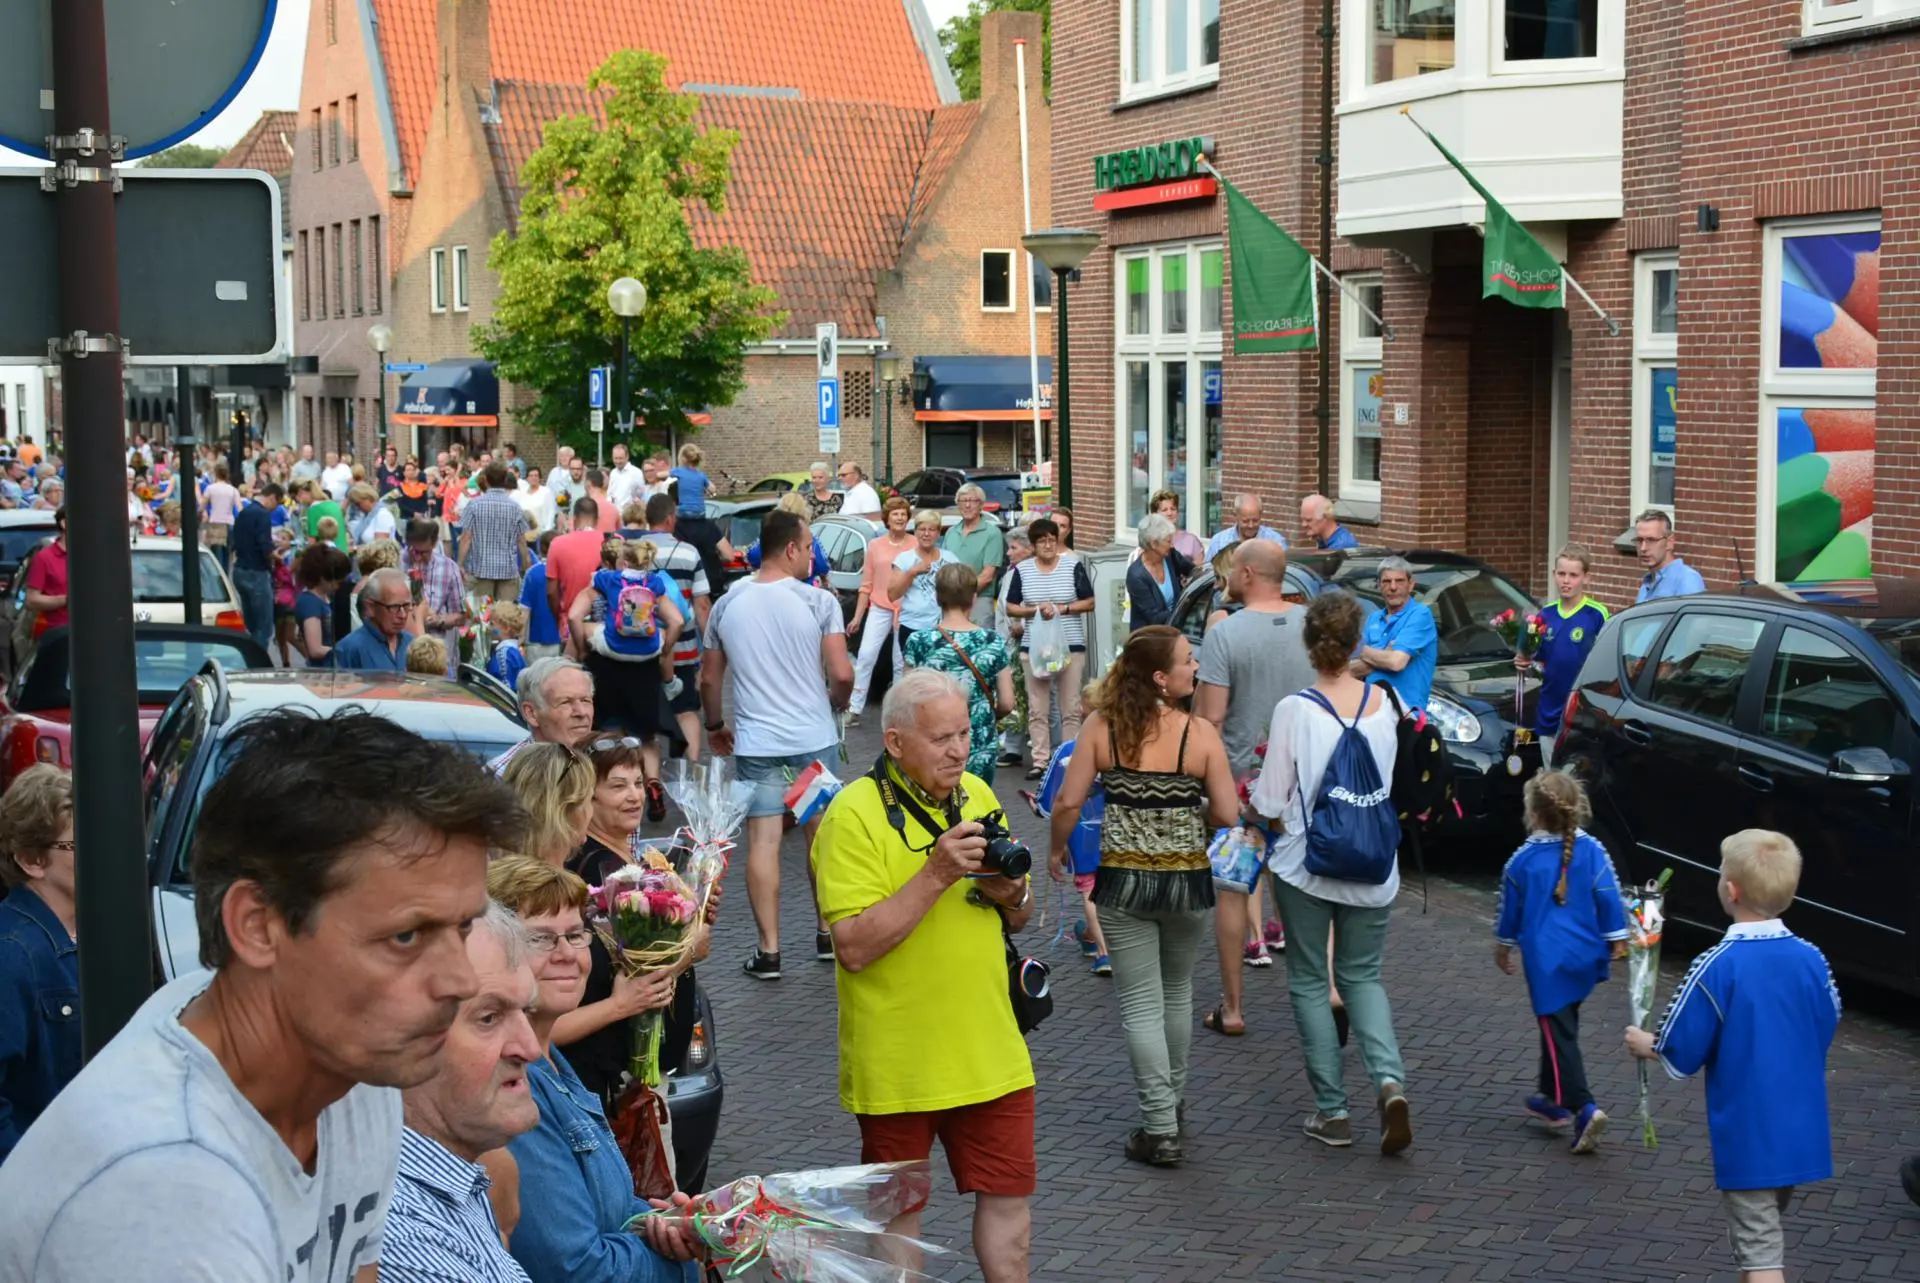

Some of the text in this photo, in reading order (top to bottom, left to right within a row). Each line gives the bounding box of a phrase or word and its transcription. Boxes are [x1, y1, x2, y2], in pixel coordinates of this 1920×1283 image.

[1521, 269, 1557, 283] SHOP
[592, 372, 600, 402] P
[821, 385, 833, 423] P
[1015, 398, 1050, 409] Hofsde
[1358, 407, 1376, 423] ING
[881, 779, 896, 806] Nikon
